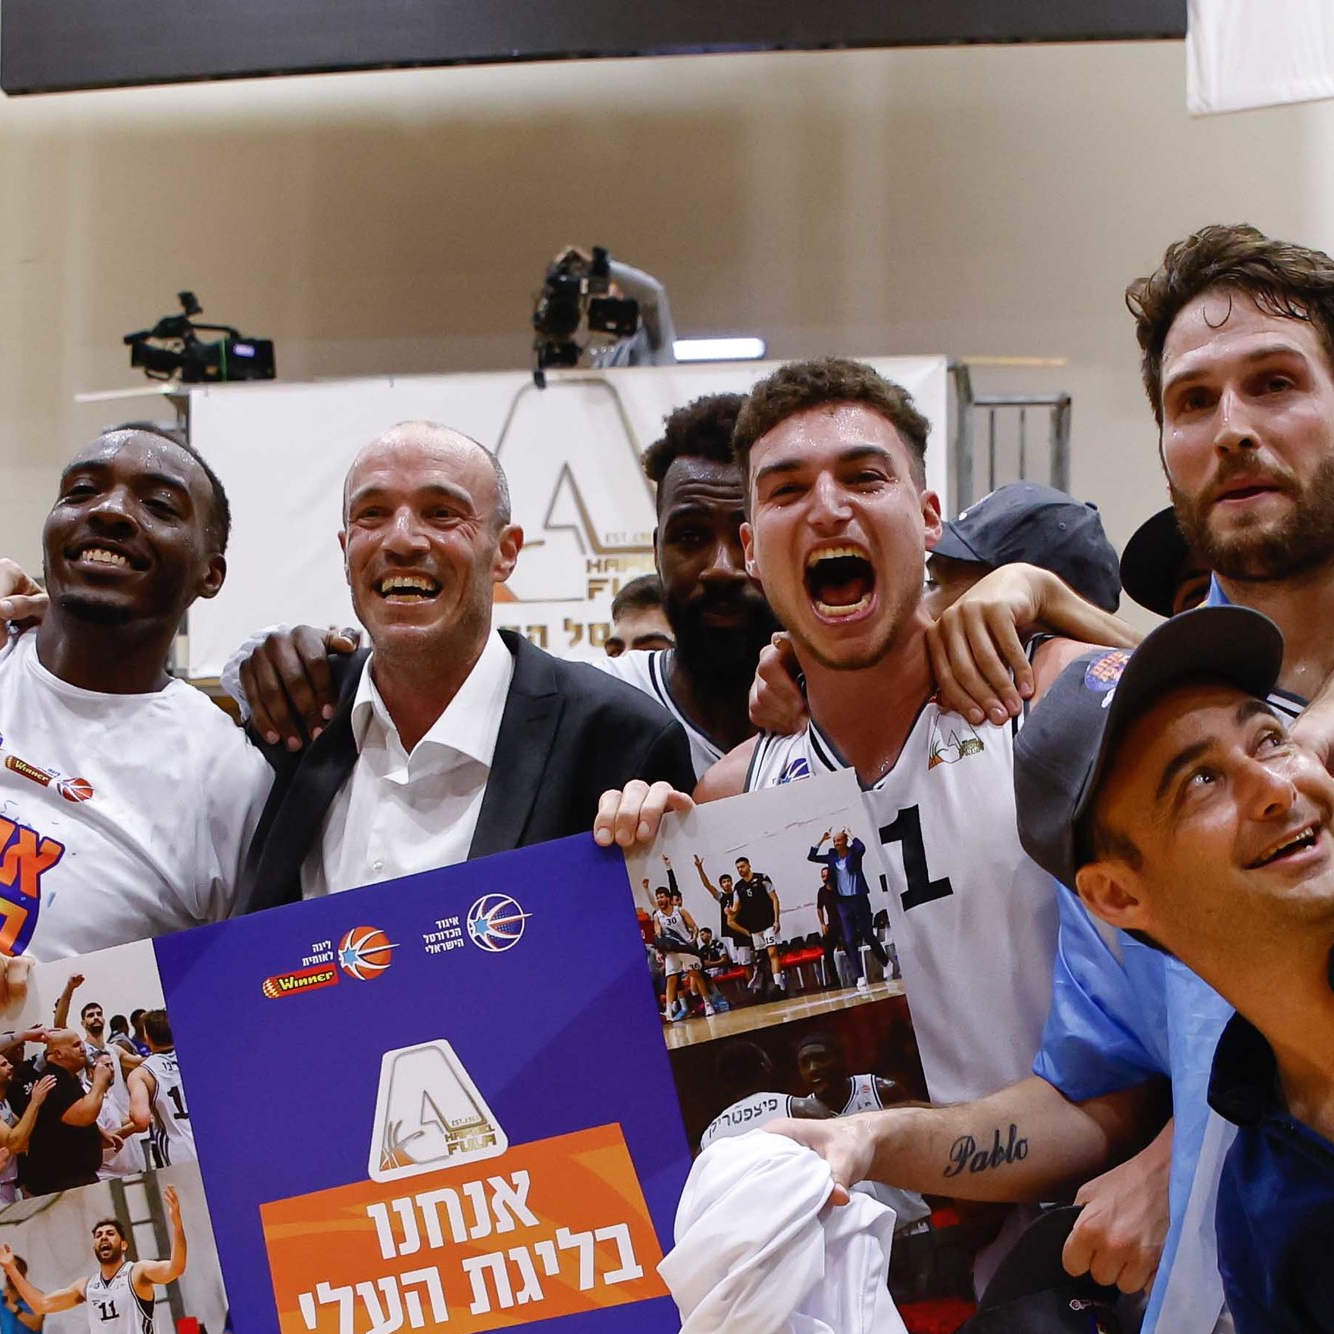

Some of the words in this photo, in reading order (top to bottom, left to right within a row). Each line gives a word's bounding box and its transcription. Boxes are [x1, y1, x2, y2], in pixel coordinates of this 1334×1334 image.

[14, 760, 49, 783] Winner
[434, 916, 460, 929] איגוד
[312, 940, 332, 953] ליגה
[422, 928, 462, 944] הכדורסל
[424, 937, 465, 955] הישראלי
[301, 951, 335, 967] לאומית
[278, 970, 335, 991] Winner
[943, 1123, 1029, 1178] Pablo
[366, 1169, 540, 1260] אנחנו
[461, 1223, 645, 1316] בליגת
[98, 1300, 120, 1321] 11
